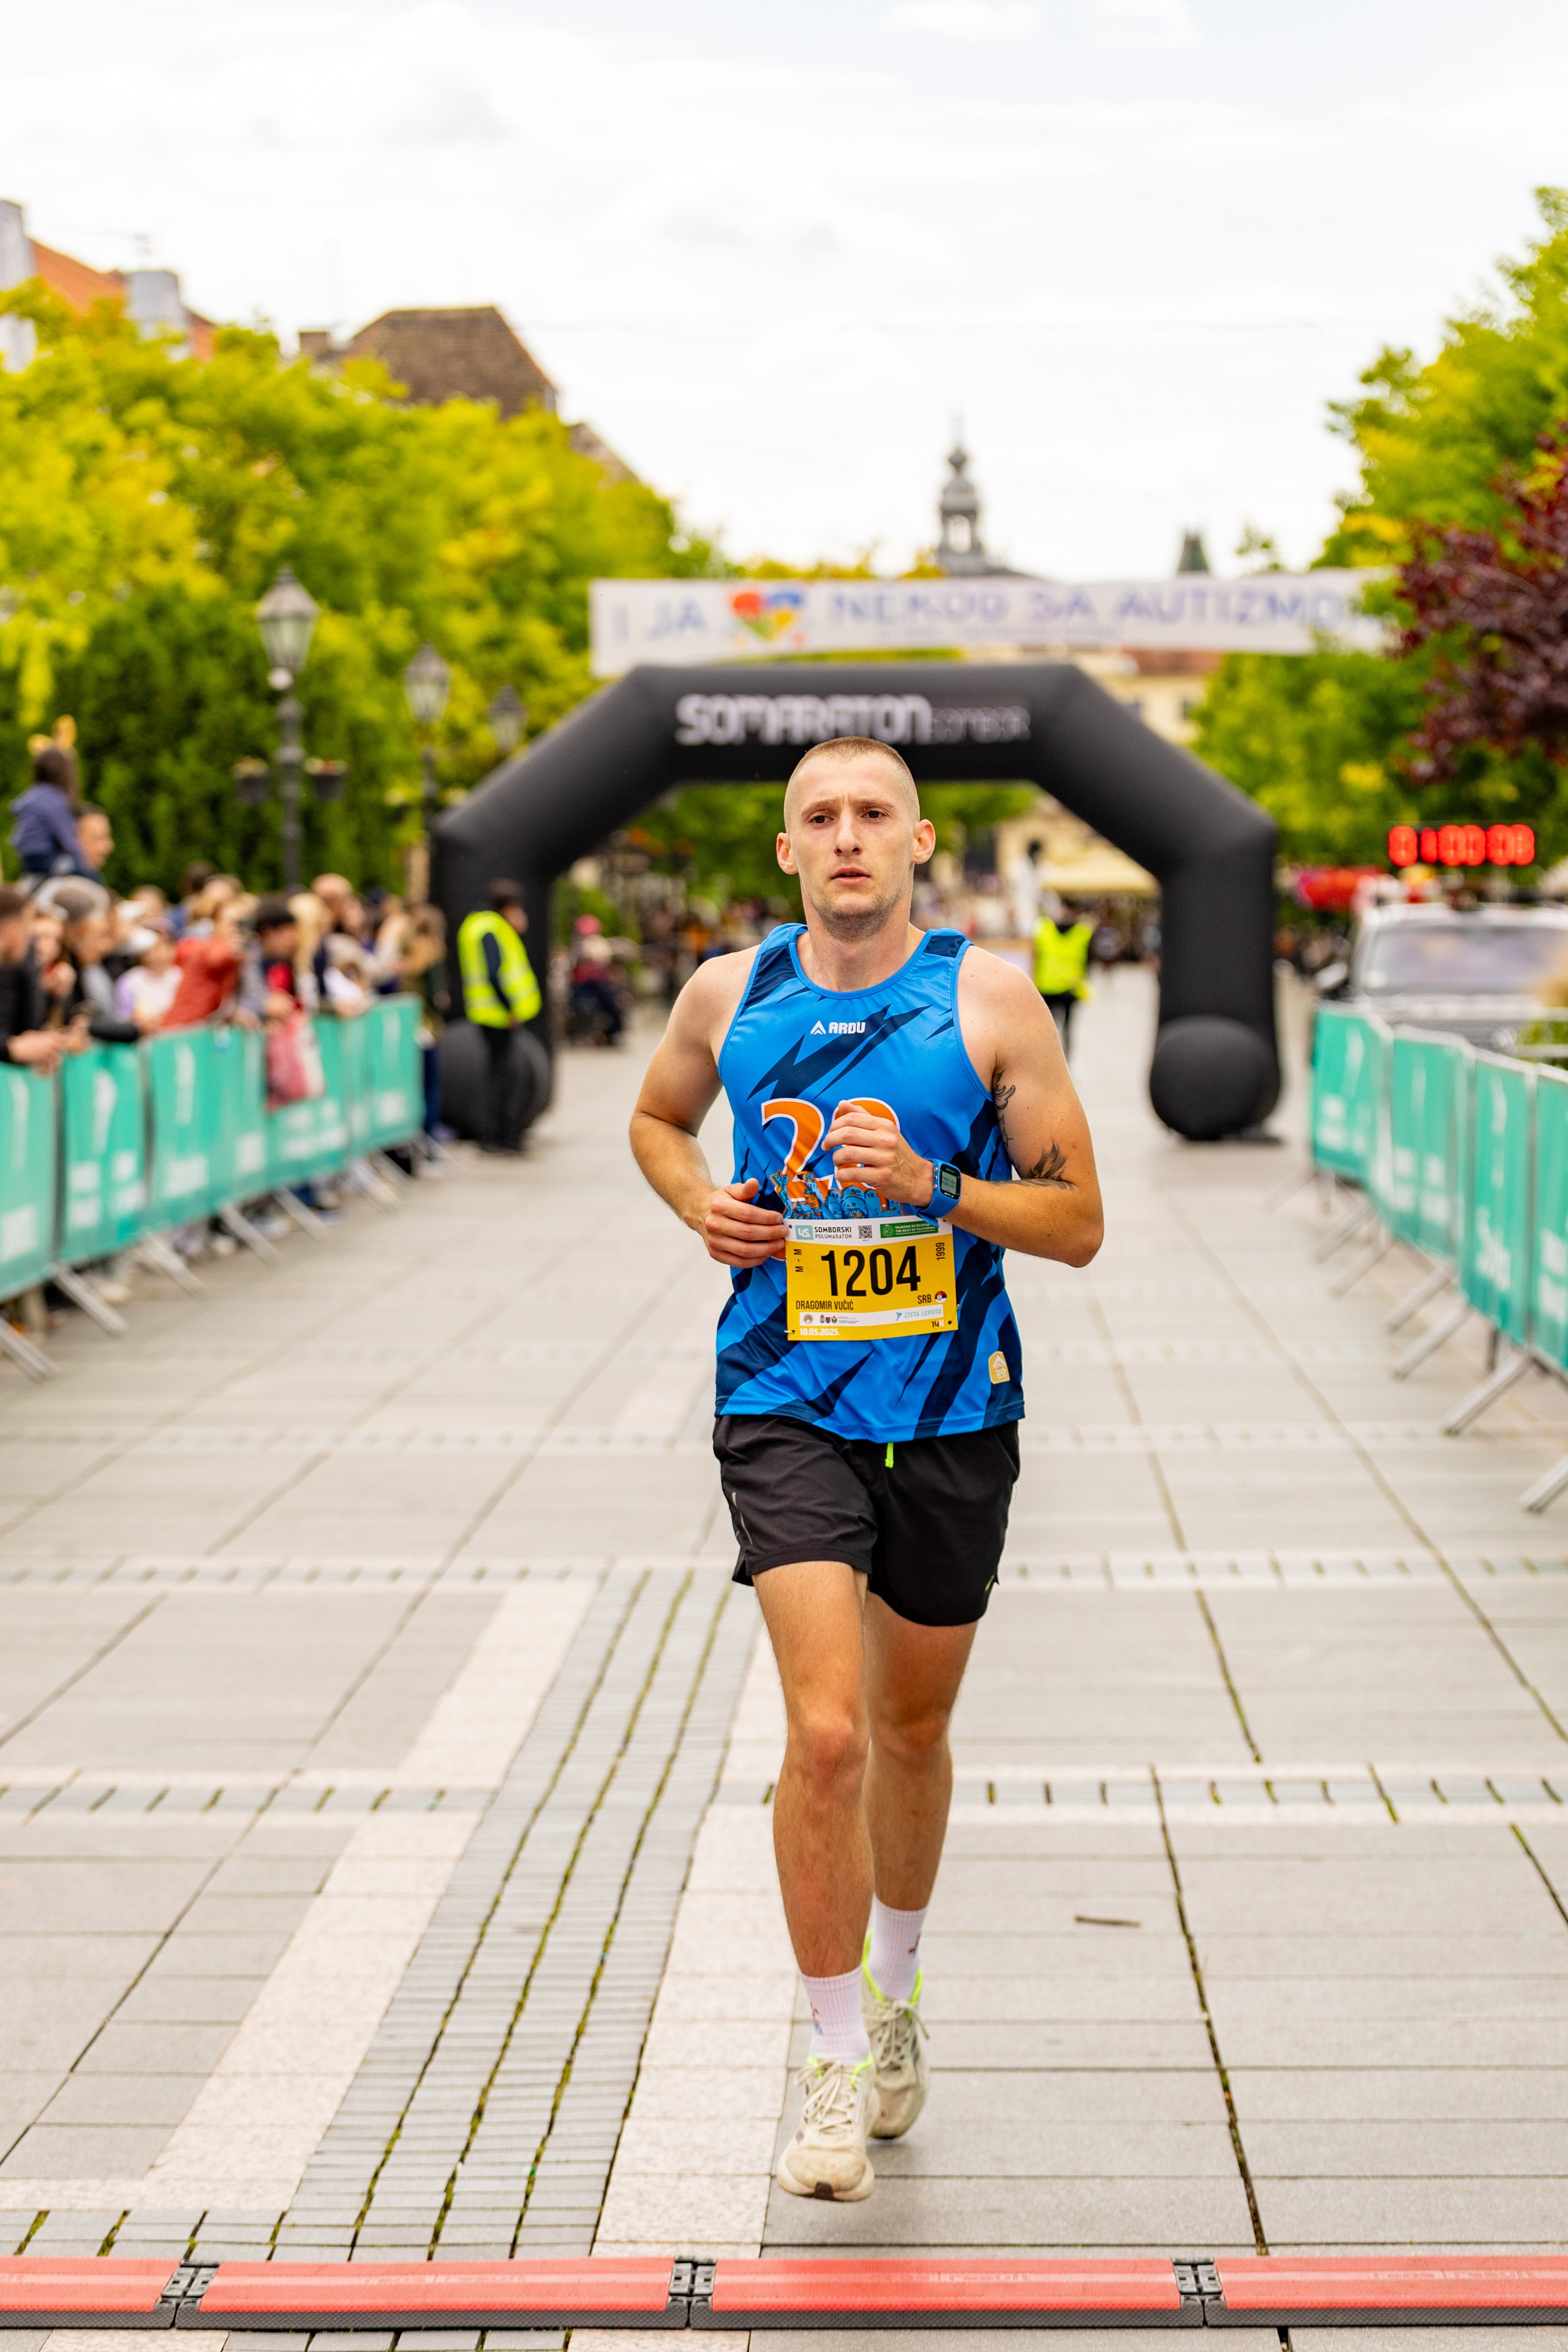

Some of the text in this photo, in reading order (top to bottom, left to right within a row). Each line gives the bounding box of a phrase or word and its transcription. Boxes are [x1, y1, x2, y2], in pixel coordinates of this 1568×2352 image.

[829, 1022, 865, 1033] ARDU
[935, 1242, 946, 1261] 1999
[821, 1245, 921, 1297] 1204
[796, 1299, 854, 1311] DRAGOMIR VUČIĆ
[918, 1294, 932, 1304] SRB
